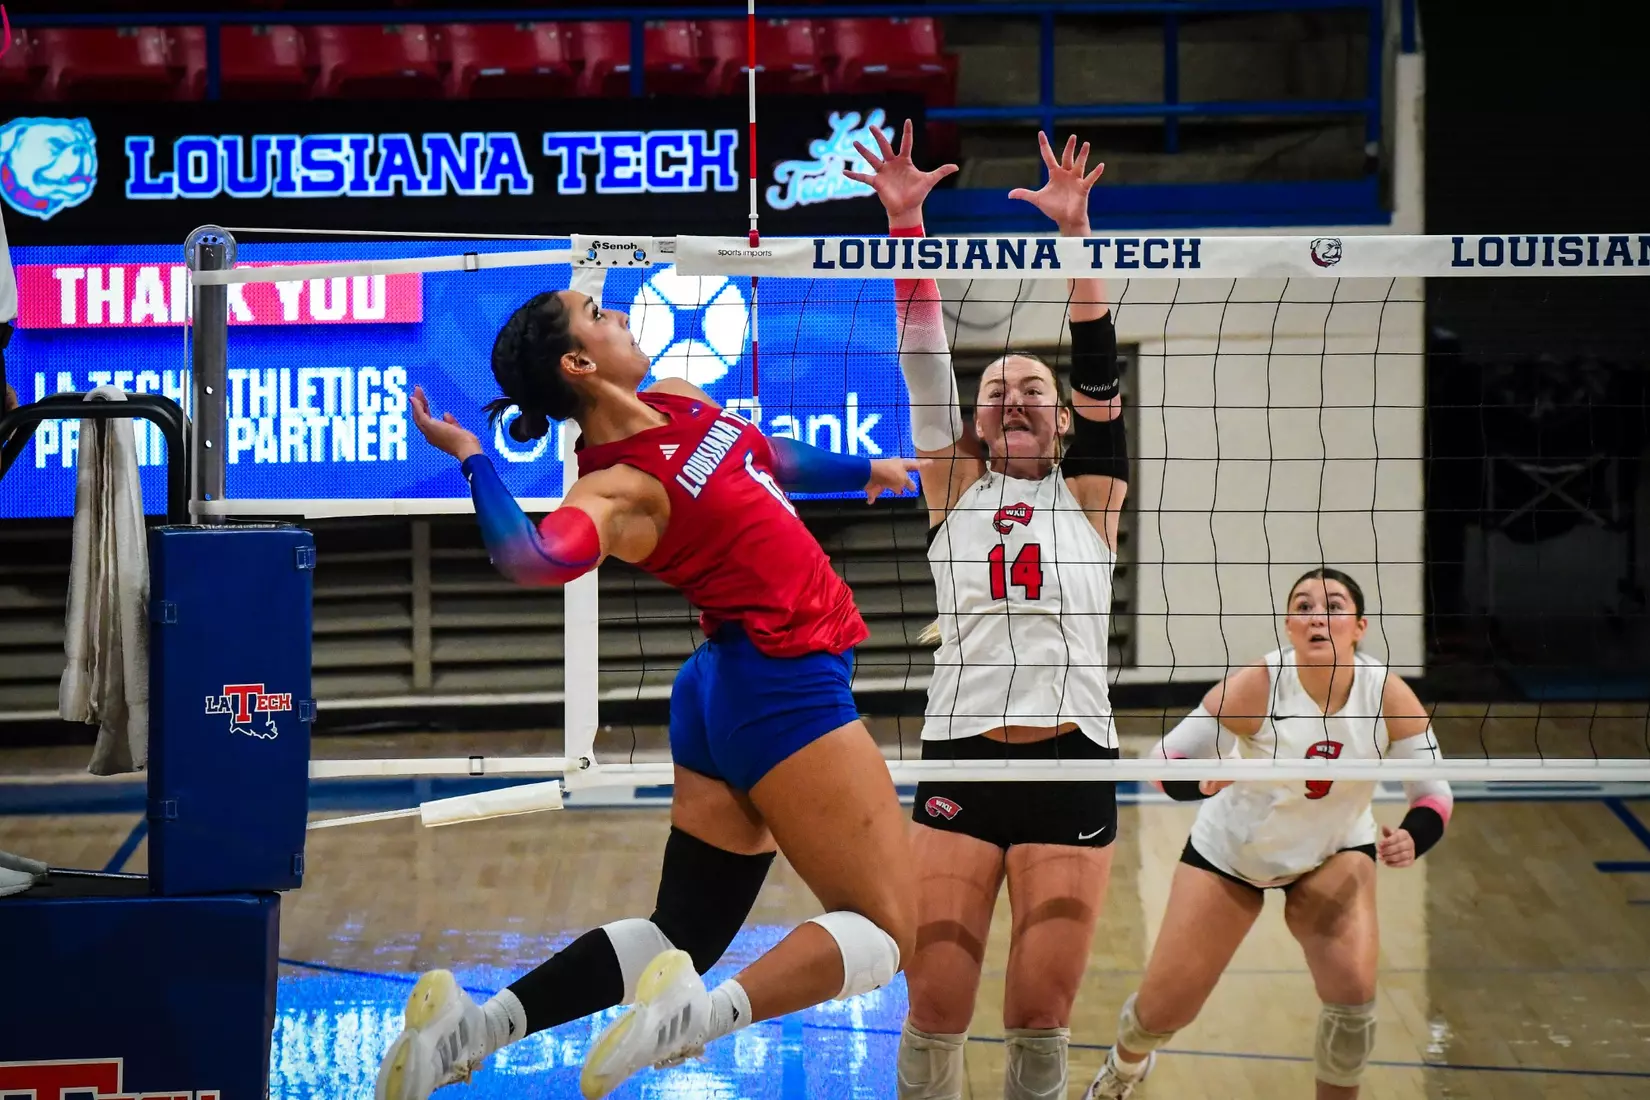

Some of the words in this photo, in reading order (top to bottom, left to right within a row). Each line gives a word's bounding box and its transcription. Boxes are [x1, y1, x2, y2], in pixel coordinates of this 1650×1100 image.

[126, 132, 533, 199] LOUISIANA
[544, 129, 738, 195] TECH
[602, 241, 638, 250] Senoh
[813, 238, 1061, 269] LOUISIANA
[1083, 238, 1201, 268] TECH
[227, 366, 407, 415] THLETICS
[228, 415, 407, 464] PARTNER
[676, 420, 742, 498] LOUISIANA
[987, 543, 1043, 600] 14
[205, 696, 232, 714] LA
